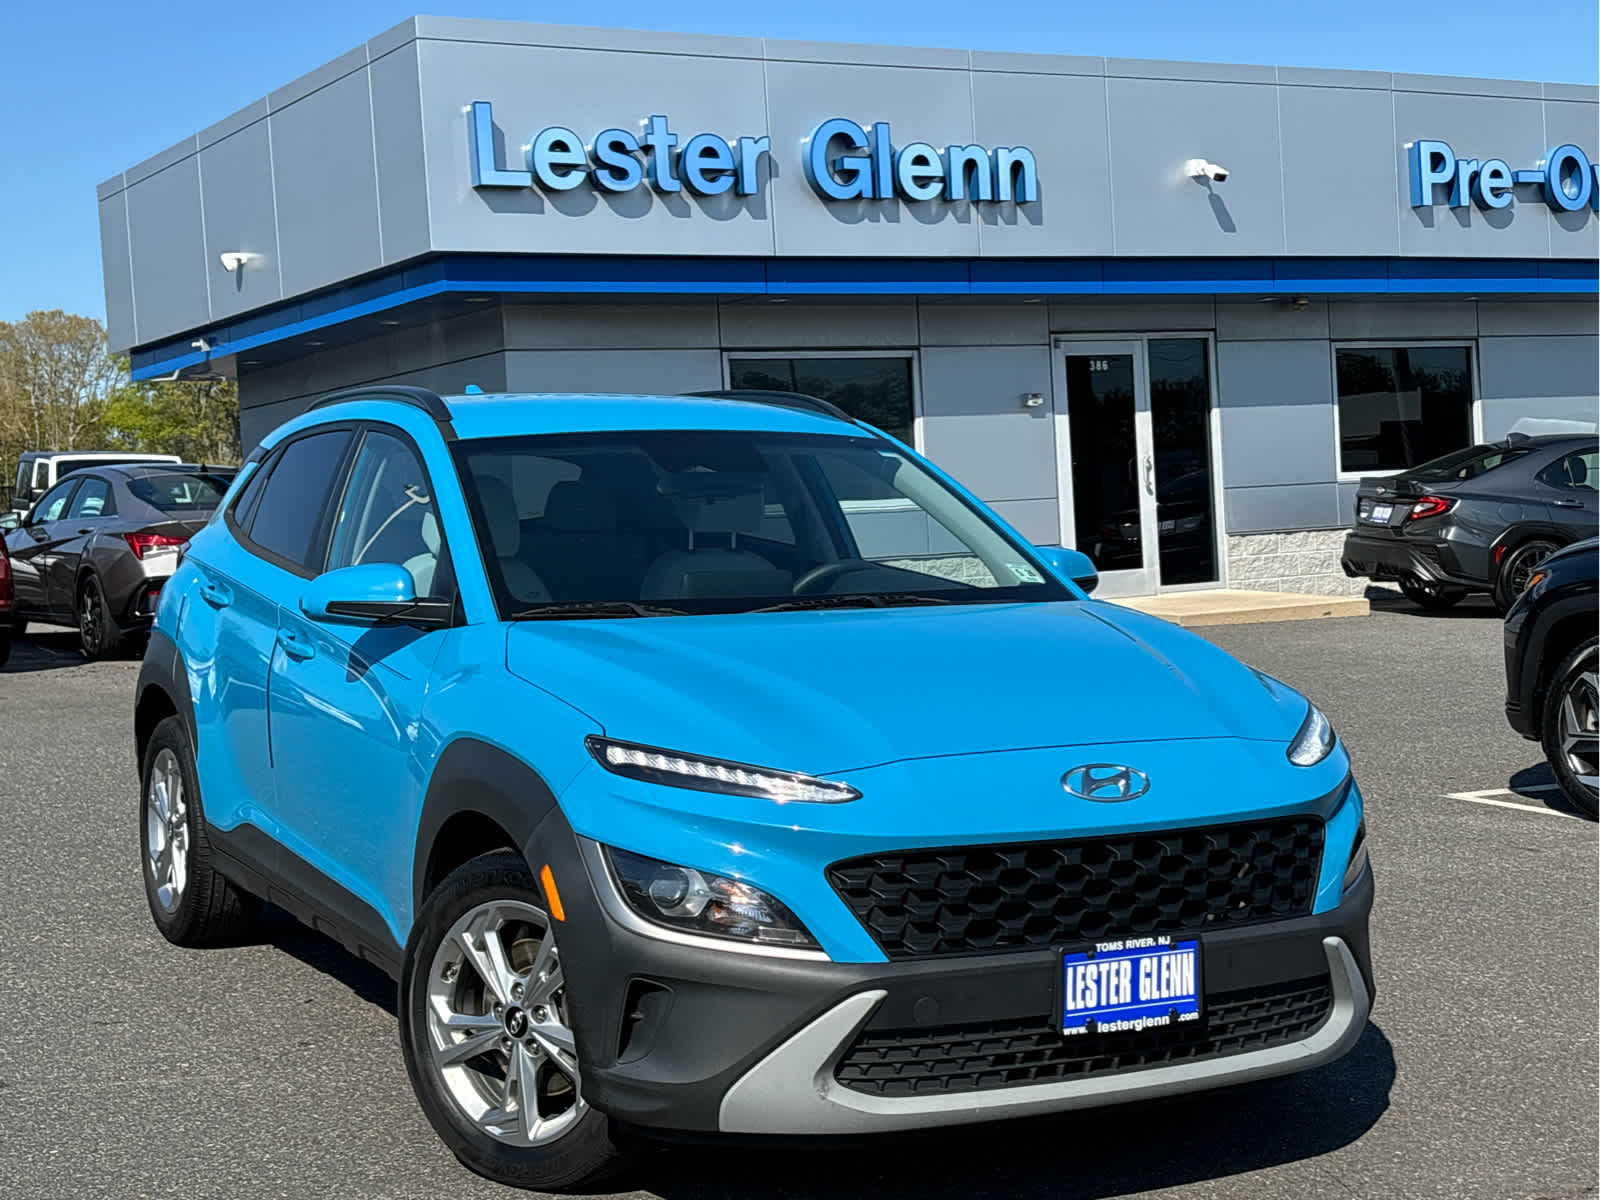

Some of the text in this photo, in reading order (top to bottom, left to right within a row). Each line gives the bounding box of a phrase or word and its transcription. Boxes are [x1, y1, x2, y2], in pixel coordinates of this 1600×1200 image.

[466, 100, 1037, 203] Lester Glenn
[1408, 140, 1599, 213] Pre-O
[1096, 942, 1124, 952] TOMS
[1158, 936, 1171, 945] NJ
[1066, 952, 1195, 1010] LESTER GLENN
[1097, 1016, 1170, 1033] lesterglenn
